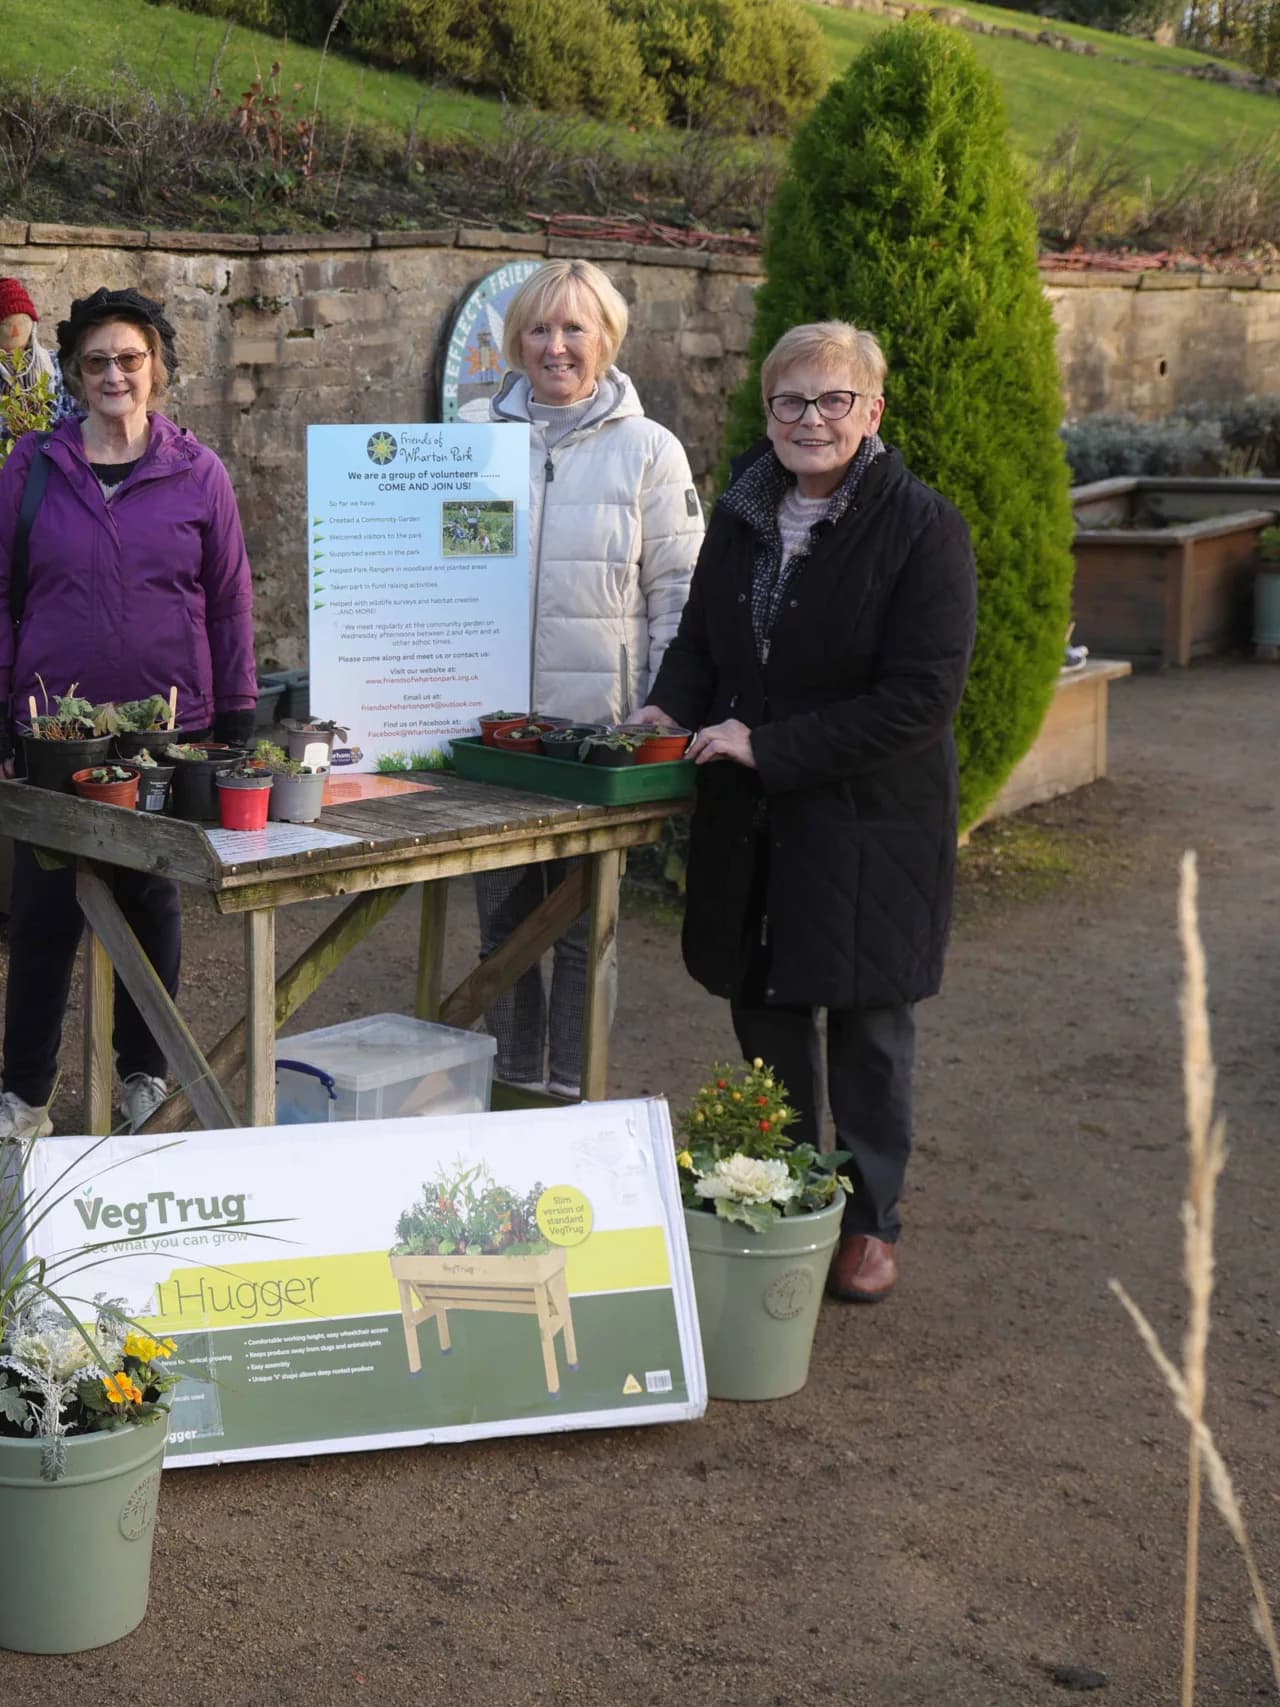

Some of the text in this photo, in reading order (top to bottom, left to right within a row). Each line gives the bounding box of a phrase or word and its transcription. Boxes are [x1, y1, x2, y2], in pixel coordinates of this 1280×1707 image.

[489, 263, 542, 296] FRIEN
[443, 291, 483, 398] REFLECT
[400, 432, 443, 448] Friends of
[400, 447, 473, 464] Wharton Park
[348, 472, 362, 480] We
[389, 473, 416, 481] group
[418, 470, 428, 478] of
[430, 470, 478, 478] volunteers
[379, 483, 406, 491] COME
[409, 483, 429, 491] AND
[456, 482, 471, 490] US!
[426, 621, 461, 629] community
[366, 675, 478, 685] www.friendsofwhartonpark.org.uk
[74, 1191, 247, 1235] VegTrug
[576, 1204, 584, 1212] of
[547, 1215, 584, 1224] standard
[549, 1225, 584, 1236] VegTrug
[112, 1235, 148, 1253] what
[151, 1235, 178, 1253] you
[183, 1236, 209, 1246] can
[212, 1231, 249, 1243] grow
[174, 1277, 320, 1319] Hugger
[248, 1338, 282, 1346] Comfortable
[267, 1349, 290, 1357] produce
[351, 1365, 374, 1374] produce
[169, 1430, 198, 1444] gger
